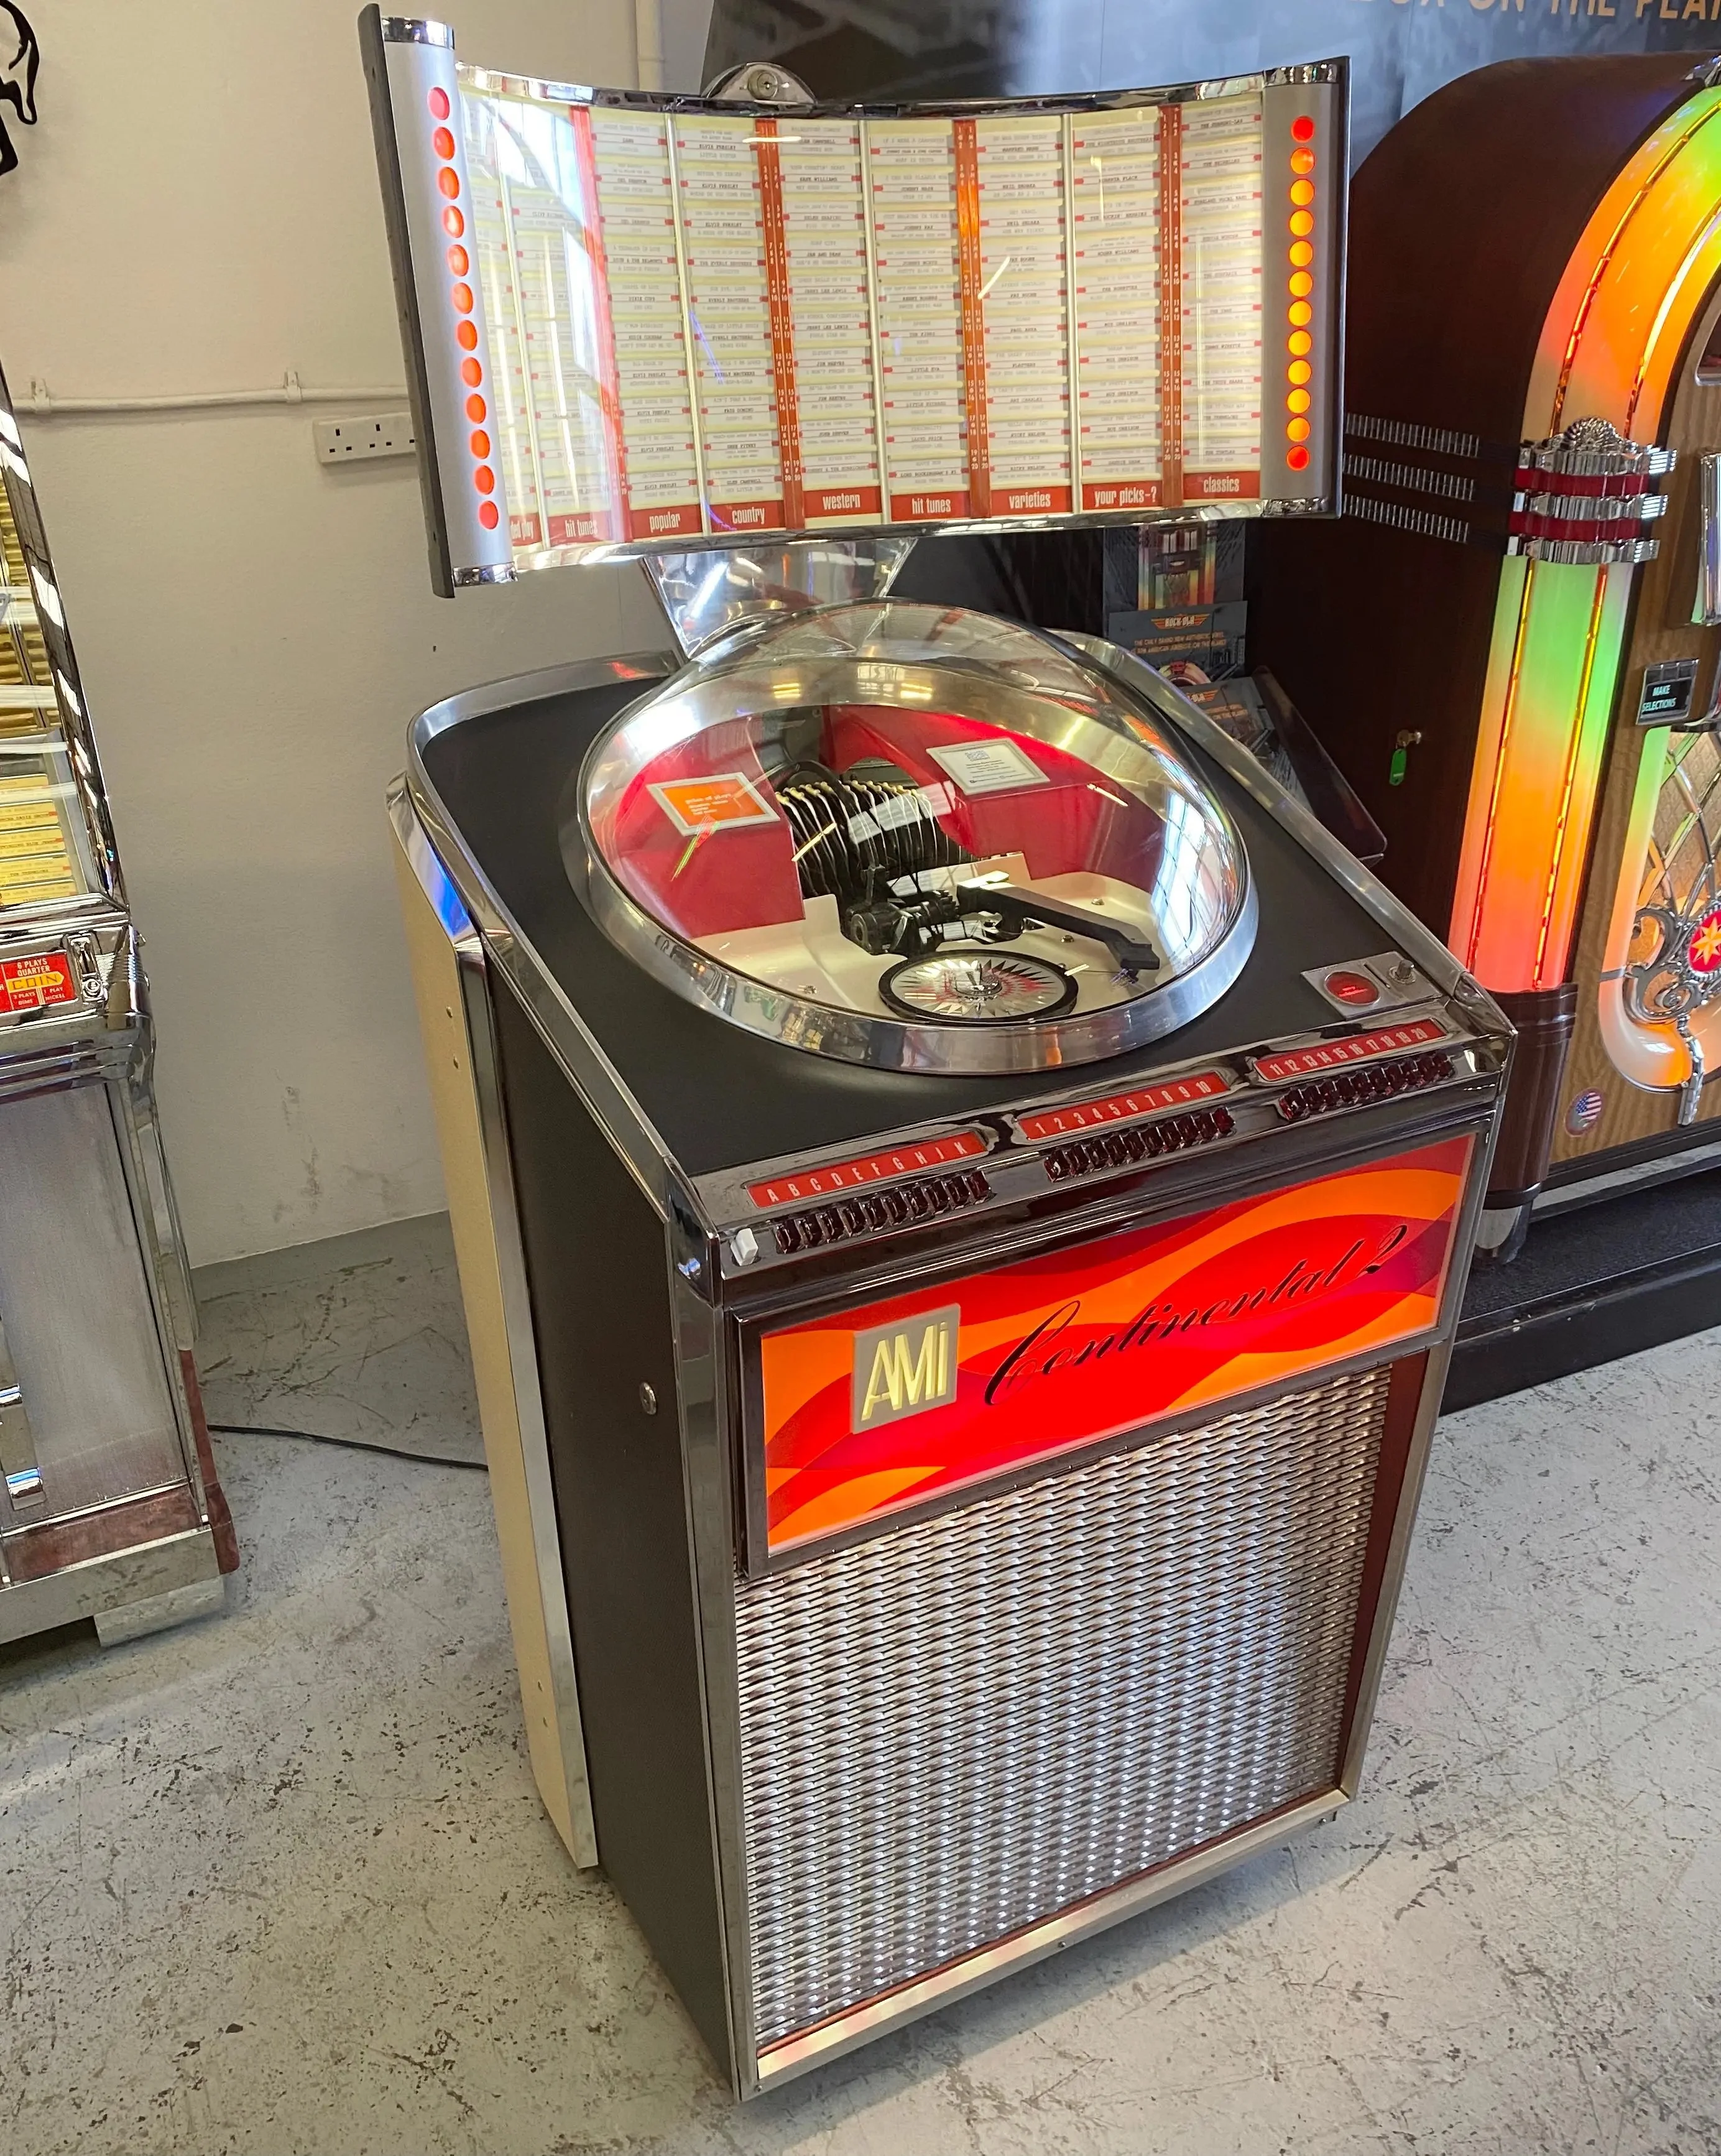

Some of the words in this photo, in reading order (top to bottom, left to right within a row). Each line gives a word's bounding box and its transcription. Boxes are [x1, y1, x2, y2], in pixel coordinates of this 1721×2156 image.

[1204, 476, 1240, 493] classics
[823, 494, 860, 510] western
[911, 497, 924, 514] hit
[926, 497, 951, 514] tunes
[1008, 493, 1051, 509] varieties
[1094, 490, 1117, 507] your
[649, 511, 680, 532] popular
[732, 506, 765, 525] country
[565, 520, 576, 538] hit
[578, 519, 598, 537] tunes
[1165, 616, 1195, 627] ROCK-OLA
[1652, 685, 1671, 696] MAKE
[1641, 698, 1677, 713] SELECTIONS
[17, 965, 50, 976] QUARTER
[24, 958, 47, 968] PLAYS
[12, 974, 58, 990] COIN
[1270, 1063, 1285, 1076] 11
[1285, 1058, 1300, 1072] 12
[1303, 1055, 1318, 1067] 13
[1317, 1051, 1333, 1063] 14
[1333, 1047, 1348, 1060] 15
[1349, 1043, 1364, 1055] 16
[1367, 1039, 1380, 1051] 17
[1380, 1035, 1396, 1047] 18
[1396, 1031, 1411, 1043] 19
[1411, 1027, 1428, 1040] 20
[1035, 1122, 1047, 1134] 1
[1054, 1117, 1066, 1129] 2
[1073, 1113, 1086, 1124] 3
[1092, 1108, 1103, 1120] 4
[1109, 1103, 1120, 1116] 5
[1127, 1099, 1138, 1111] 6
[1145, 1094, 1156, 1106] 7
[1161, 1090, 1174, 1102] 8
[1179, 1086, 1191, 1098] 9
[1196, 1081, 1211, 1093] 10
[767, 1188, 778, 1202] A
[788, 1183, 800, 1196] B
[811, 1178, 822, 1191] C
[831, 1173, 843, 1186] D
[852, 1168, 864, 1182] E
[871, 1162, 881, 1175] F
[892, 1157, 905, 1170] G
[915, 1151, 928, 1165] H
[935, 1147, 945, 1159] J
[955, 1141, 967, 1154] K
[985, 1238, 1365, 1405] Continental
[1357, 1224, 1408, 1275] 2
